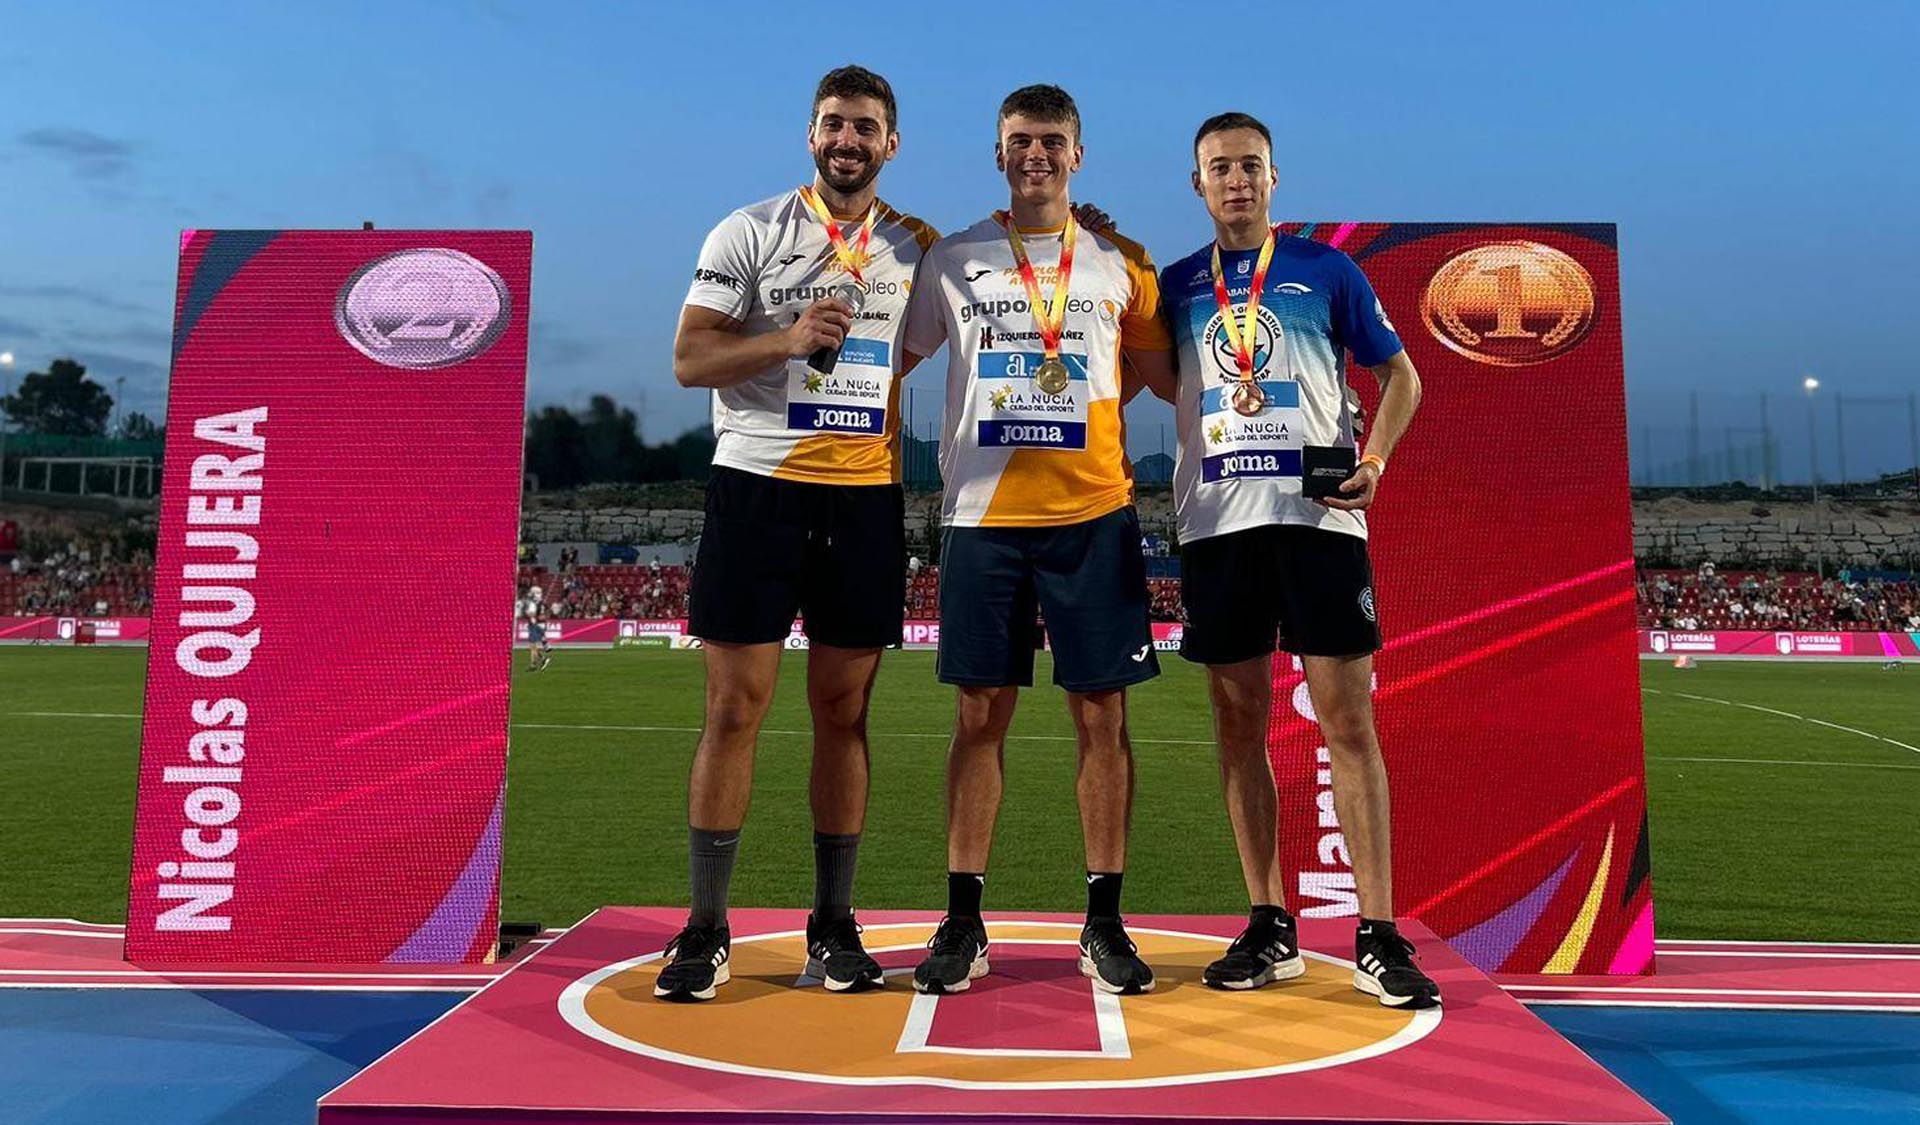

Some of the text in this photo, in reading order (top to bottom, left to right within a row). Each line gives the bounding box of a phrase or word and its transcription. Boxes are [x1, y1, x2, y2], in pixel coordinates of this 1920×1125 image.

[703, 269, 737, 288] SPORT
[1480, 265, 1537, 338] 1
[825, 378, 840, 388] LA
[1010, 394, 1024, 404] LA
[1670, 633, 1715, 643] LOTERÍAS
[1796, 635, 1840, 644] LOTERÍAS
[155, 406, 268, 931] Nicolas QUIJERA
